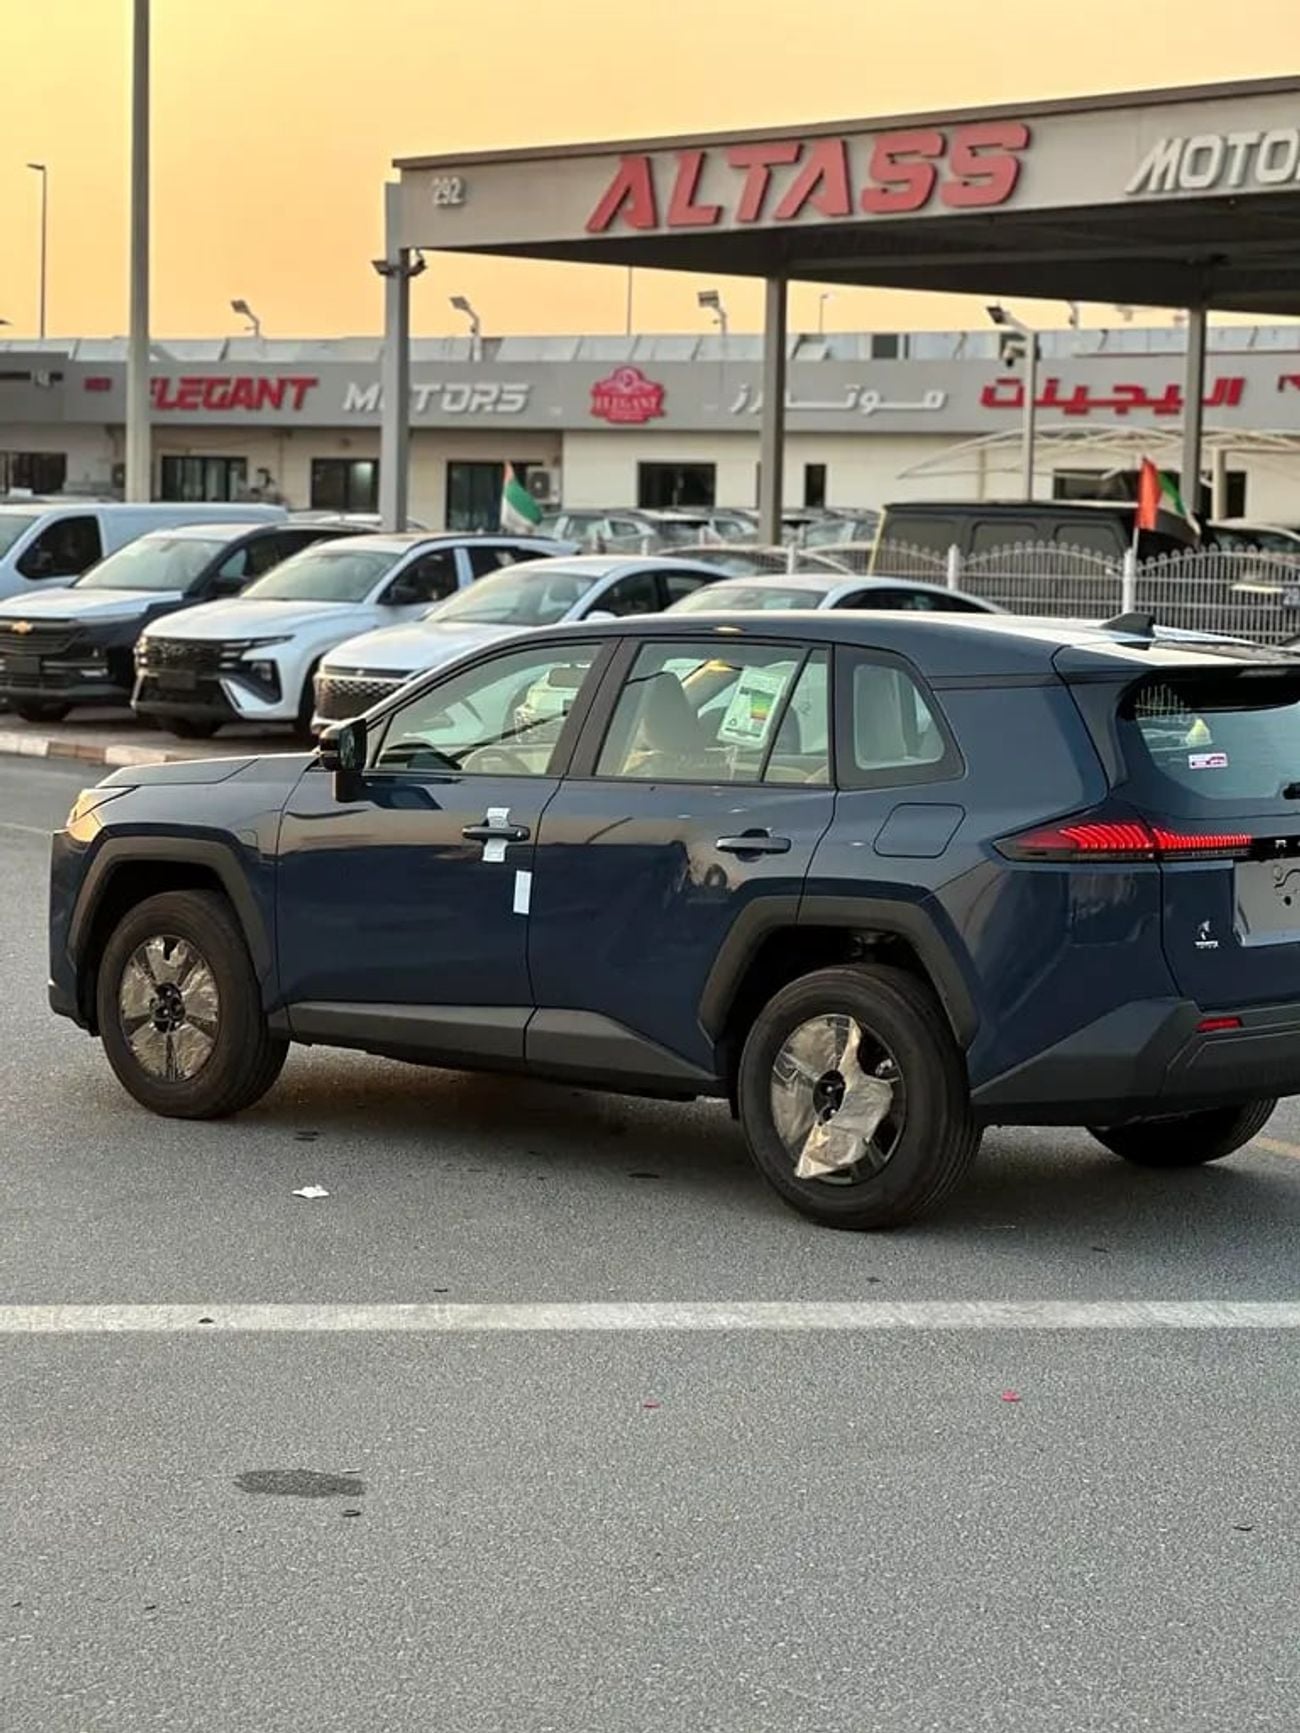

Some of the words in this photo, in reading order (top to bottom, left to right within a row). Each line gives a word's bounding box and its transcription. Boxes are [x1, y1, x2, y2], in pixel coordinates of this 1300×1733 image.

[432, 176, 462, 205] 292
[585, 123, 1030, 233] ALTASS
[1124, 128, 1300, 196] MOTO
[342, 382, 530, 413] MTORS
